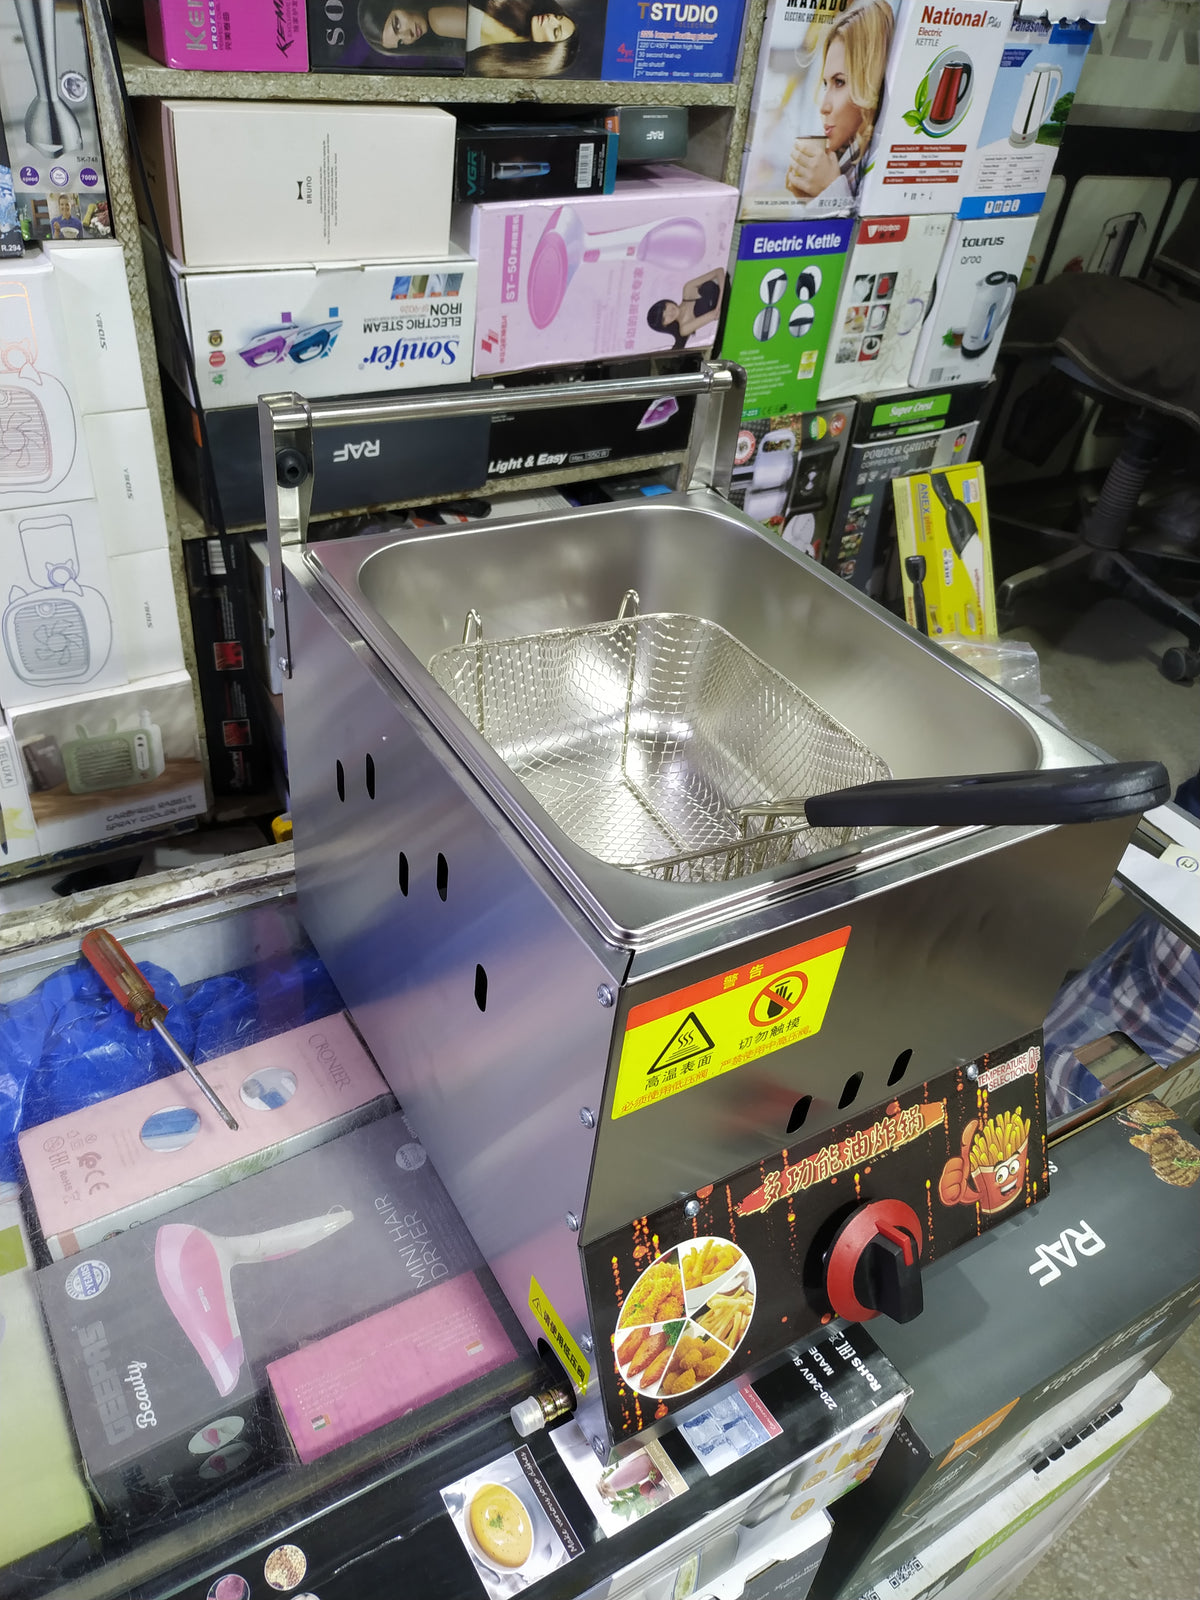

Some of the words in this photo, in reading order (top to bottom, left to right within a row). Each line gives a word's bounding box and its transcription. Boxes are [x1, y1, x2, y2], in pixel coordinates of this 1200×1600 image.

[920, 5, 988, 28] National
[915, 37, 939, 47] KETTLE
[918, 26, 943, 38] Electric
[646, 130, 664, 139] RAF
[26, 168, 31, 176] 2
[467, 151, 477, 196] VGR
[753, 235, 802, 254] Electric
[805, 233, 841, 250] Kettle
[962, 235, 1005, 248] taurus
[430, 303, 463, 315] IRON
[363, 320, 404, 334] STEAM
[406, 317, 462, 329] ELECTRIC
[364, 337, 460, 371] Sonifer
[333, 439, 380, 463] RAF
[488, 459, 523, 474] Light
[524, 456, 535, 467] &
[537, 452, 567, 469] Easy
[863, 445, 902, 460] POWDER
[918, 483, 930, 513] ANEX
[106, 816, 137, 831] SPRAY
[723, 963, 765, 990] 警告
[738, 1016, 801, 1050] 切勿触摸
[307, 1033, 353, 1093] CRONIER
[644, 1053, 714, 1091] 高温表面
[977, 1053, 1028, 1086] TEMPERATURE
[988, 1063, 1028, 1091] SELECTION
[761, 1103, 925, 1213] 多功能油炸锅
[375, 1193, 410, 1241] HAIR
[407, 1210, 450, 1280] DRYER
[1028, 1218, 1107, 1288] RAF
[80, 1265, 94, 1289] YEARS
[398, 1243, 433, 1290] MINI
[808, 1346, 834, 1376] MADE
[851, 1358, 882, 1391] RoHS
[80, 1321, 134, 1446] GEEPAS
[124, 1360, 158, 1430] Beauty
[800, 1367, 838, 1410] 220-240V
[520, 1453, 536, 1477] dishes
[533, 1479, 548, 1497] soup
[544, 1499, 563, 1527] various
[561, 1529, 577, 1553] Make
